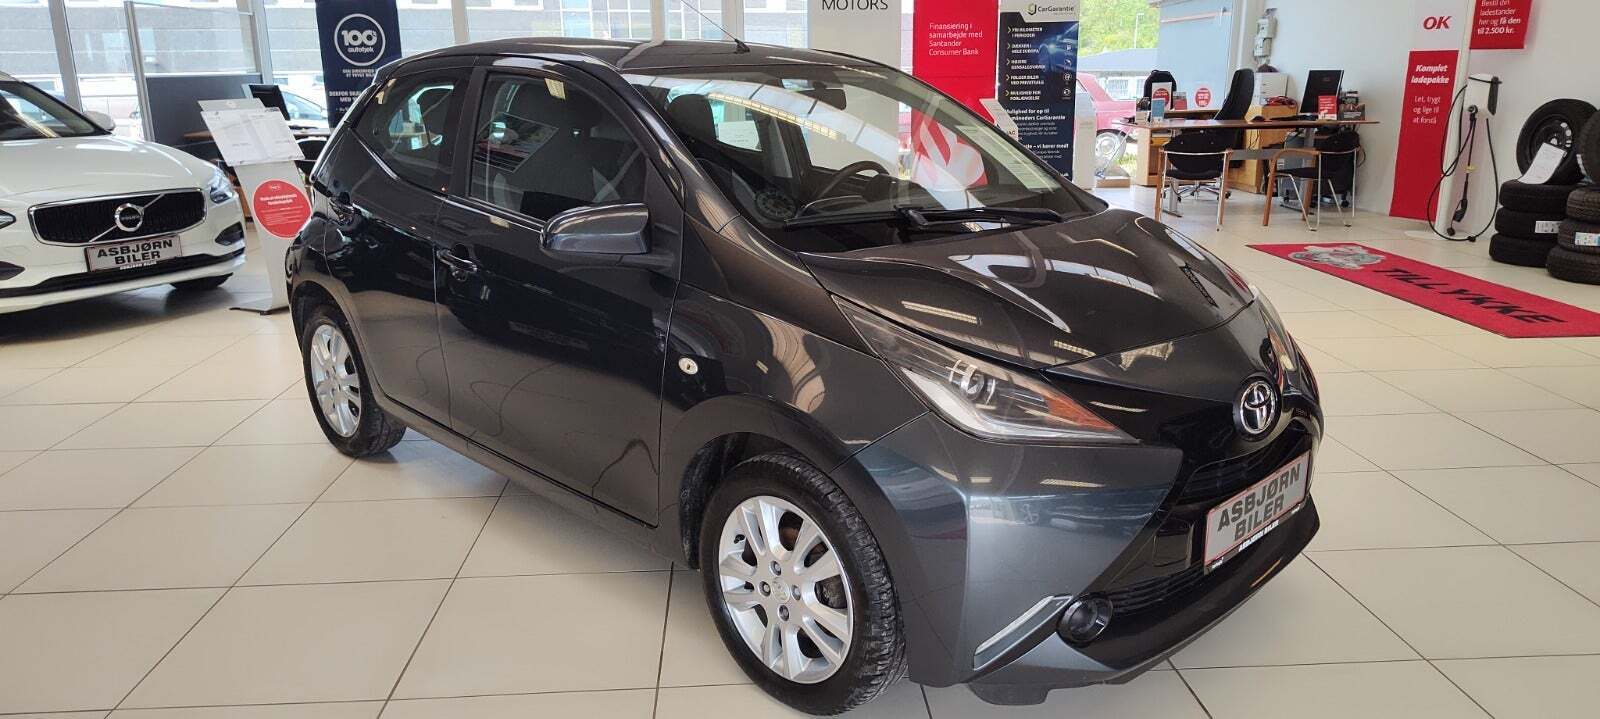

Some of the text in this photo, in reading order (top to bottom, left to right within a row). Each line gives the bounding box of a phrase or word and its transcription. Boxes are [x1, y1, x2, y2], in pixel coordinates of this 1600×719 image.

[821, 0, 889, 11] MOTORS
[1480, 8, 1516, 16] ladestander
[1423, 16, 1452, 30] OK
[1499, 17, 1507, 25] få
[929, 23, 968, 31] Finansiering
[1477, 27, 1485, 35] til
[929, 31, 967, 39] samarbejde
[929, 48, 962, 56] Consumer
[1415, 64, 1448, 73] Komplet
[1411, 76, 1449, 85] ladepakke
[1426, 96, 1441, 105] trygt
[1422, 106, 1433, 114] lige
[1420, 116, 1437, 125] forstå
[97, 239, 173, 258] ASBJØRN
[114, 251, 161, 265] BILER
[1372, 268, 1568, 323] TILLYKKE
[1217, 463, 1301, 532] ASBJØRN
[1234, 494, 1284, 541] BILER
